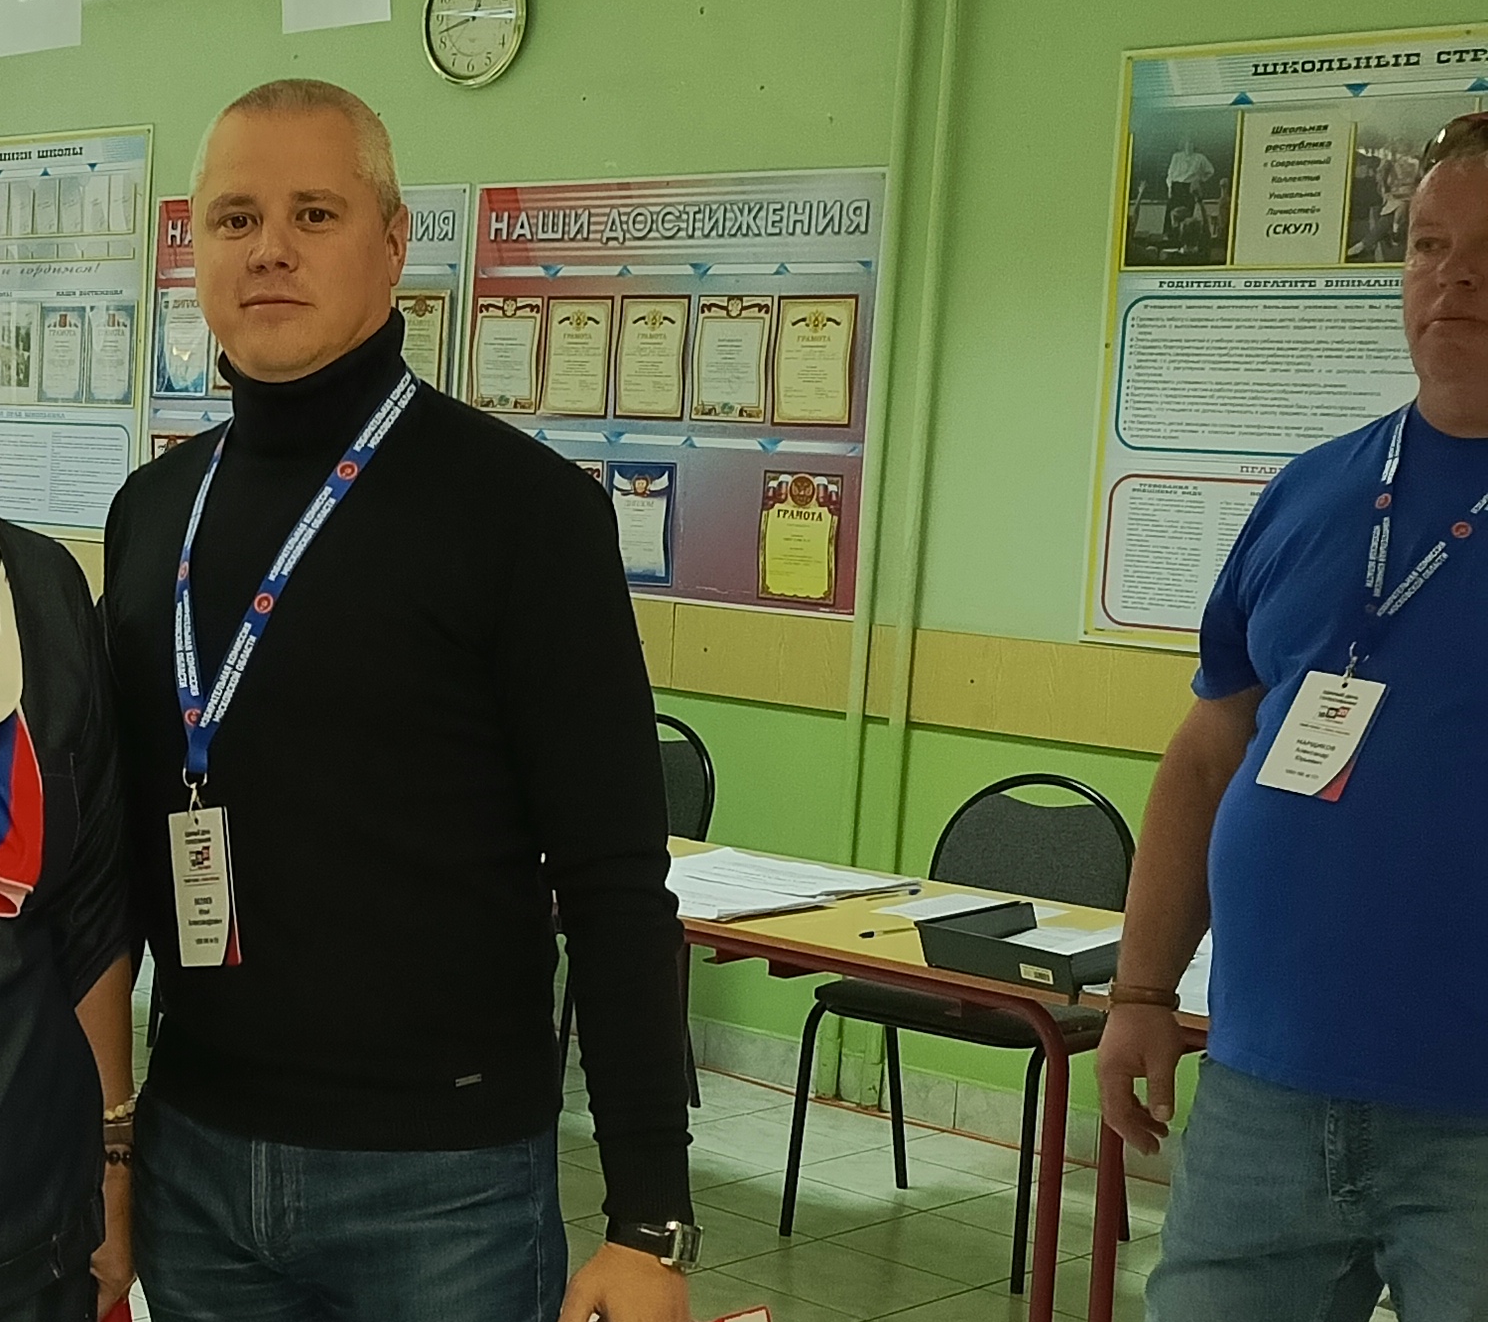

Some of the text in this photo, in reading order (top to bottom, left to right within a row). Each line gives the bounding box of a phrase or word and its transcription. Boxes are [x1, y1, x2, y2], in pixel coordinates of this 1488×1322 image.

[436, 14, 444, 26] 9
[439, 37, 447, 50] 8
[498, 34, 506, 49] 4
[451, 52, 459, 68] 7
[484, 51, 492, 67] 5
[1251, 48, 1488, 76] ШКОЛЬНЫЕ СТР
[467, 59, 475, 73] 6
[1271, 124, 1329, 134] Школьная
[37, 145, 84, 160] ШКОЛЫ
[1265, 140, 1332, 153] республика
[1270, 157, 1332, 168] Современный
[1271, 175, 1321, 183] Коллектив
[488, 199, 871, 246] НАШИ ДОСТИЖЕНИЯ
[1266, 222, 1319, 237] (СКУЛ)
[1244, 280, 1317, 288] ОБРАТИТЕ
[172, 298, 200, 309] ДИПЛО
[1240, 465, 1282, 474] ПРАВ
[776, 509, 823, 522] ГРАМОТА
[226, 621, 252, 666] КОМИССИЯ
[212, 634, 257, 723] МОСКОВСКОЙ ОБЛАСТИ
